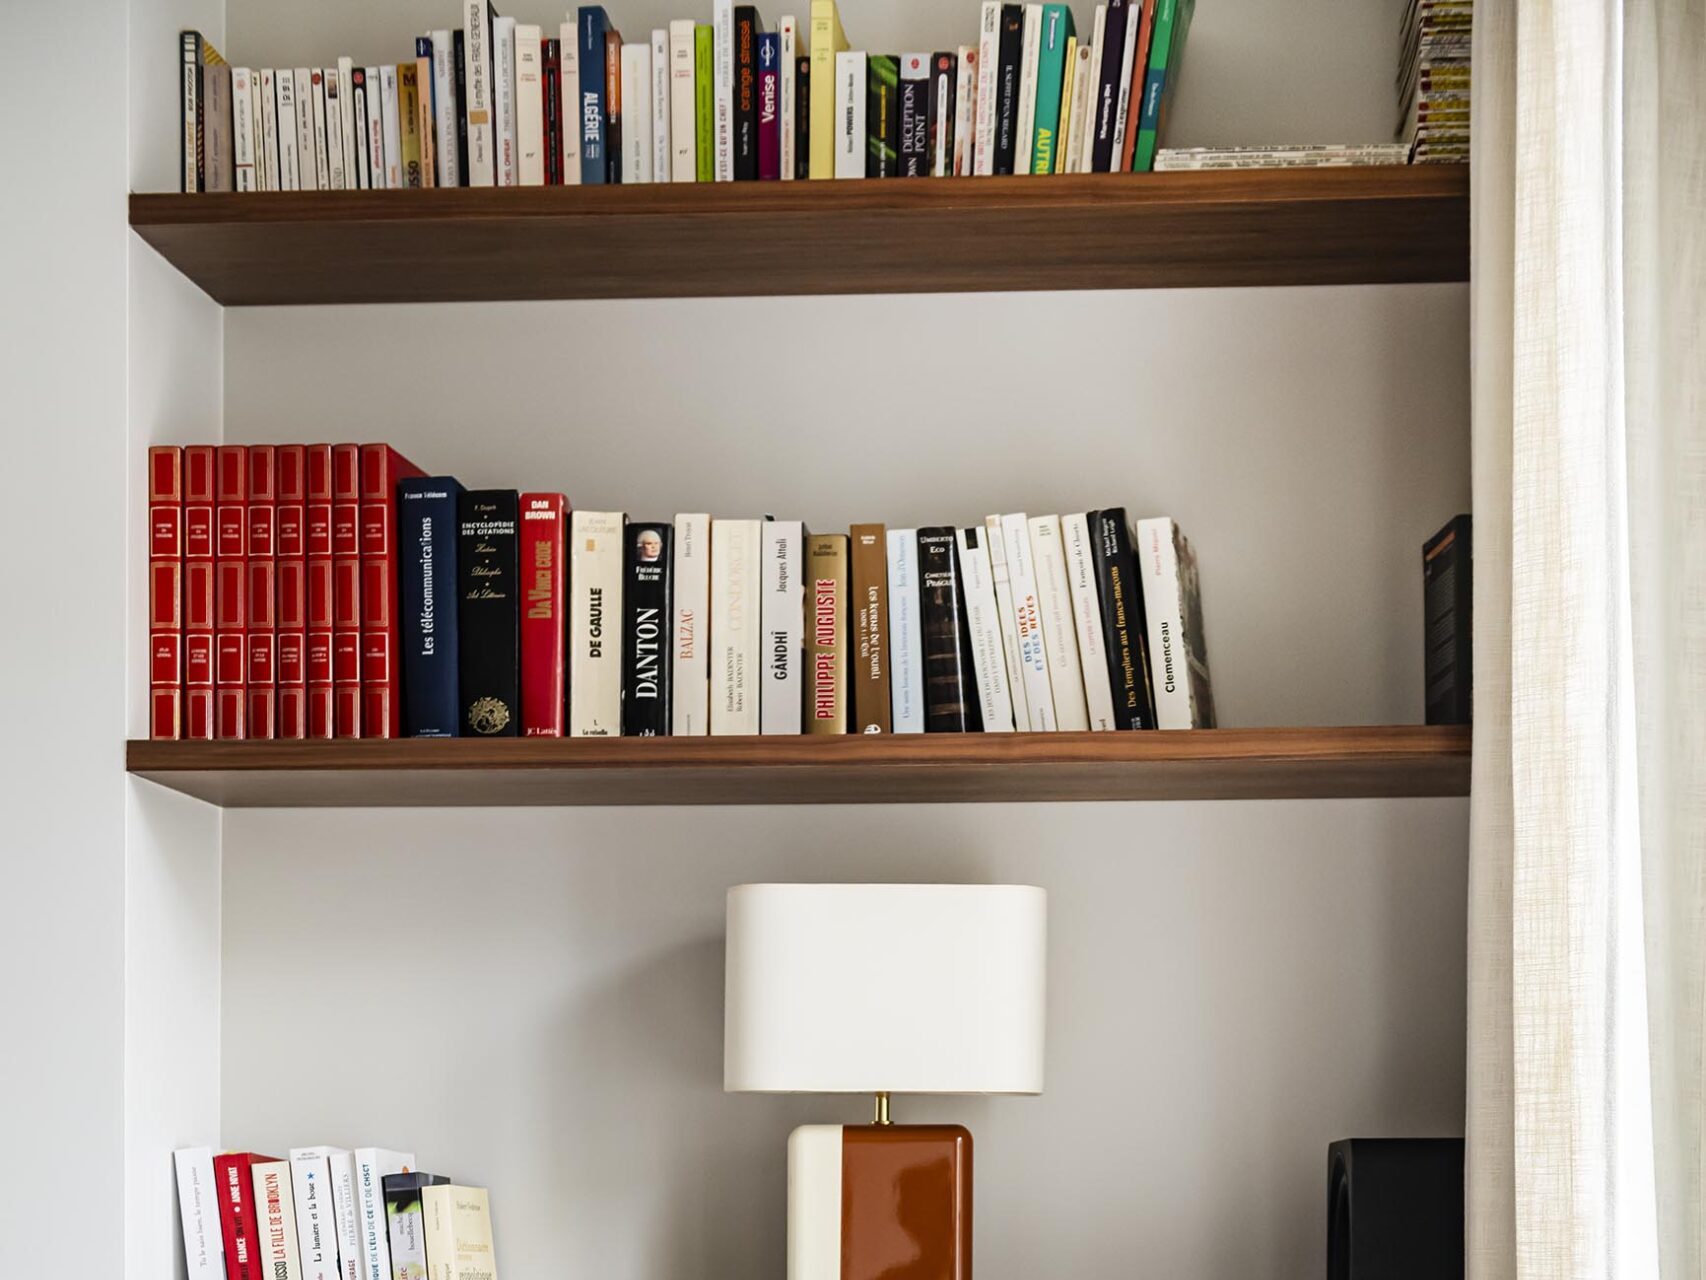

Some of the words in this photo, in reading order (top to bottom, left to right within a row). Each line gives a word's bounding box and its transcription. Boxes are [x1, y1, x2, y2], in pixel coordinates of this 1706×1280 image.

[738, 20, 751, 64] stressé
[740, 67, 752, 112] orange
[761, 74, 775, 123] Venise
[583, 92, 602, 142] ALGÉRIE
[902, 83, 914, 153] DECEPTION
[915, 113, 926, 152] POINT
[1035, 128, 1052, 175] AUTR
[524, 511, 556, 521] BROWN
[531, 500, 549, 509] DAN
[476, 527, 515, 535] CITATIONS
[535, 541, 552, 568] CODE
[775, 538, 787, 560] Attali
[419, 516, 434, 631] télécommunications
[775, 562, 788, 593] Jacques
[1074, 557, 1088, 589] François
[1110, 566, 1127, 628] francs-maçons
[589, 587, 602, 638] GAULLE
[815, 579, 837, 648] AUGUSTE
[1017, 606, 1029, 638] IDÉES
[1025, 595, 1038, 630] RÊVES
[421, 634, 434, 655] Les
[679, 608, 695, 659] BALZAC
[1031, 633, 1041, 655] DES
[1119, 629, 1129, 646] aux
[589, 643, 602, 658] DE
[635, 607, 659, 698] DANTON
[1023, 641, 1033, 663] DES
[1160, 621, 1176, 693] Clemenceau
[726, 646, 734, 682] BADINTER
[736, 652, 744, 689] BADINTER
[1035, 658, 1044, 672] ET
[1121, 647, 1136, 689] Templiers
[815, 653, 837, 720] PHILIPPE
[1126, 691, 1137, 708] Des
[227, 1167, 239, 1186] NIVAT
[362, 1164, 371, 1188] CHSCT
[230, 1185, 241, 1204] ANNE
[265, 1174, 281, 1216] BROOKLYN
[306, 1182, 316, 1201] boue
[364, 1188, 372, 1198] DE
[307, 1203, 317, 1211] la
[365, 1199, 373, 1209] ET
[366, 1210, 374, 1220] CE
[269, 1217, 282, 1227] DE
[367, 1220, 376, 1230] DE
[271, 1227, 284, 1249] FILLE
[309, 1224, 320, 1251] lumière
[367, 1231, 377, 1251] L'ÉLU
[236, 1238, 248, 1264] FRANCE
[274, 1250, 286, 1261] LA
[312, 1253, 322, 1263] La
[370, 1252, 378, 1262] DE
[199, 1258, 207, 1268] Tu
